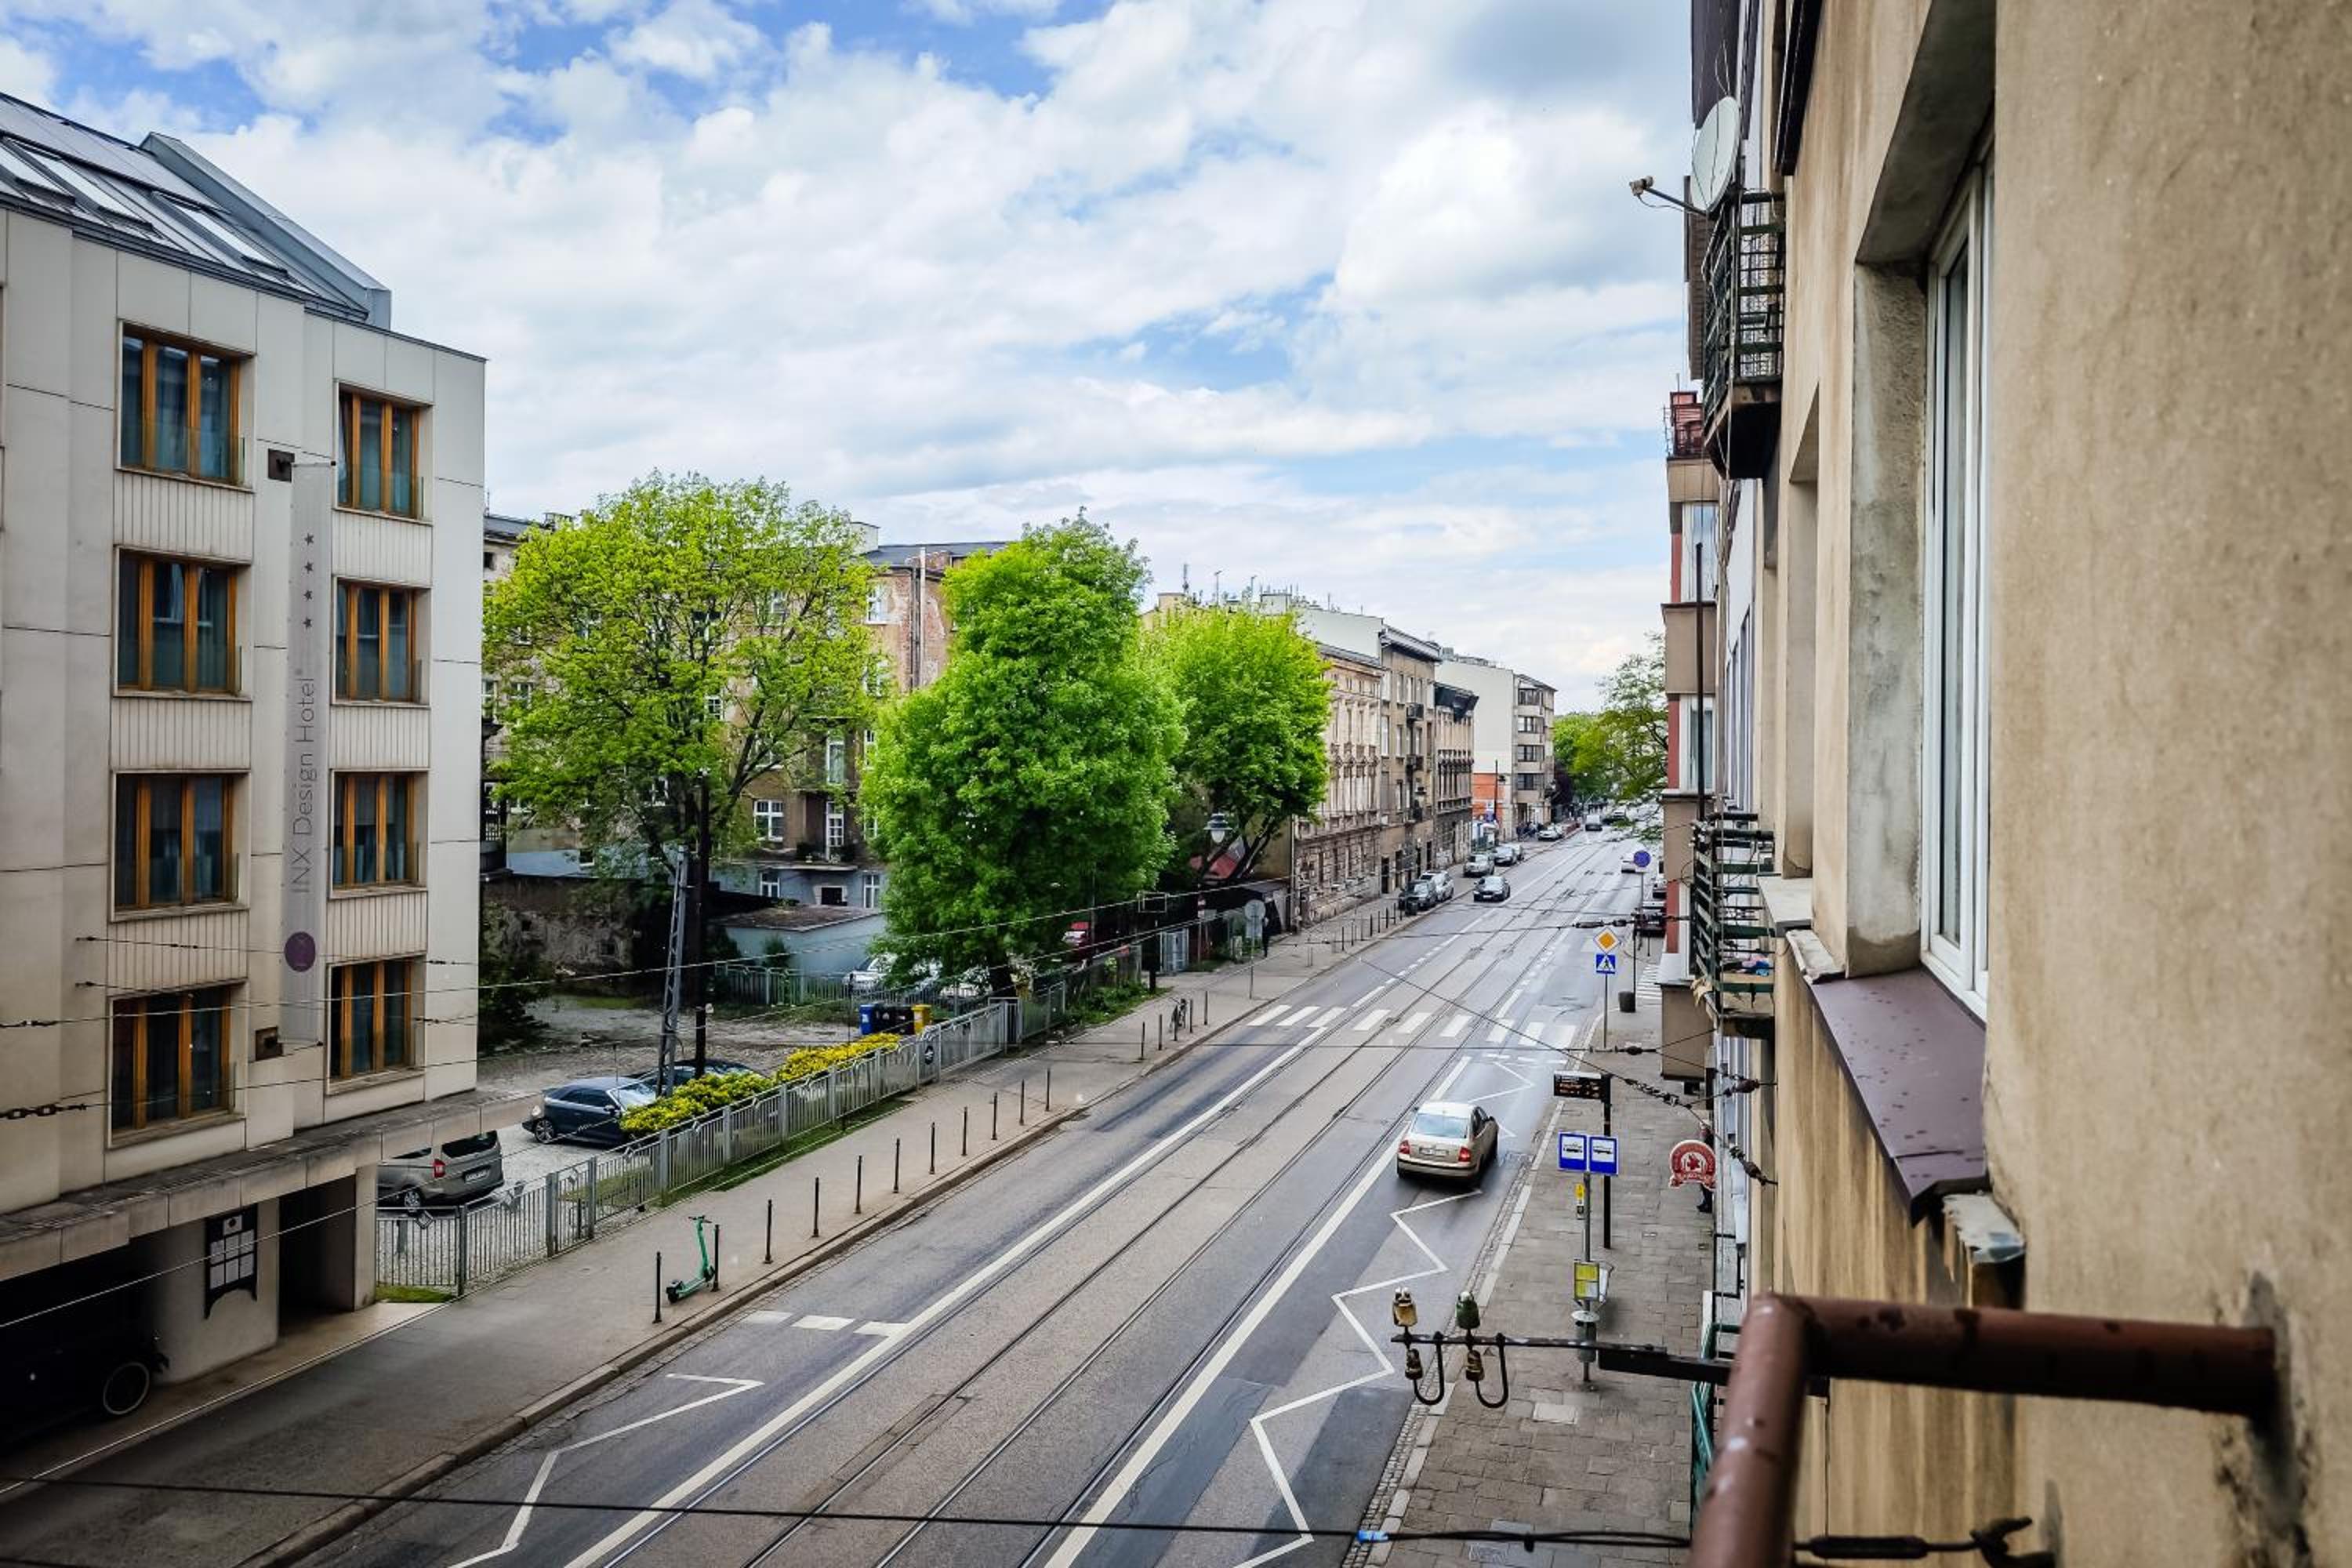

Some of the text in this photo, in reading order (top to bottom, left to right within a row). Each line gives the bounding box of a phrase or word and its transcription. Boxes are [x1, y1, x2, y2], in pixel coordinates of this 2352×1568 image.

[289, 678, 317, 893] INX Design Hotel
